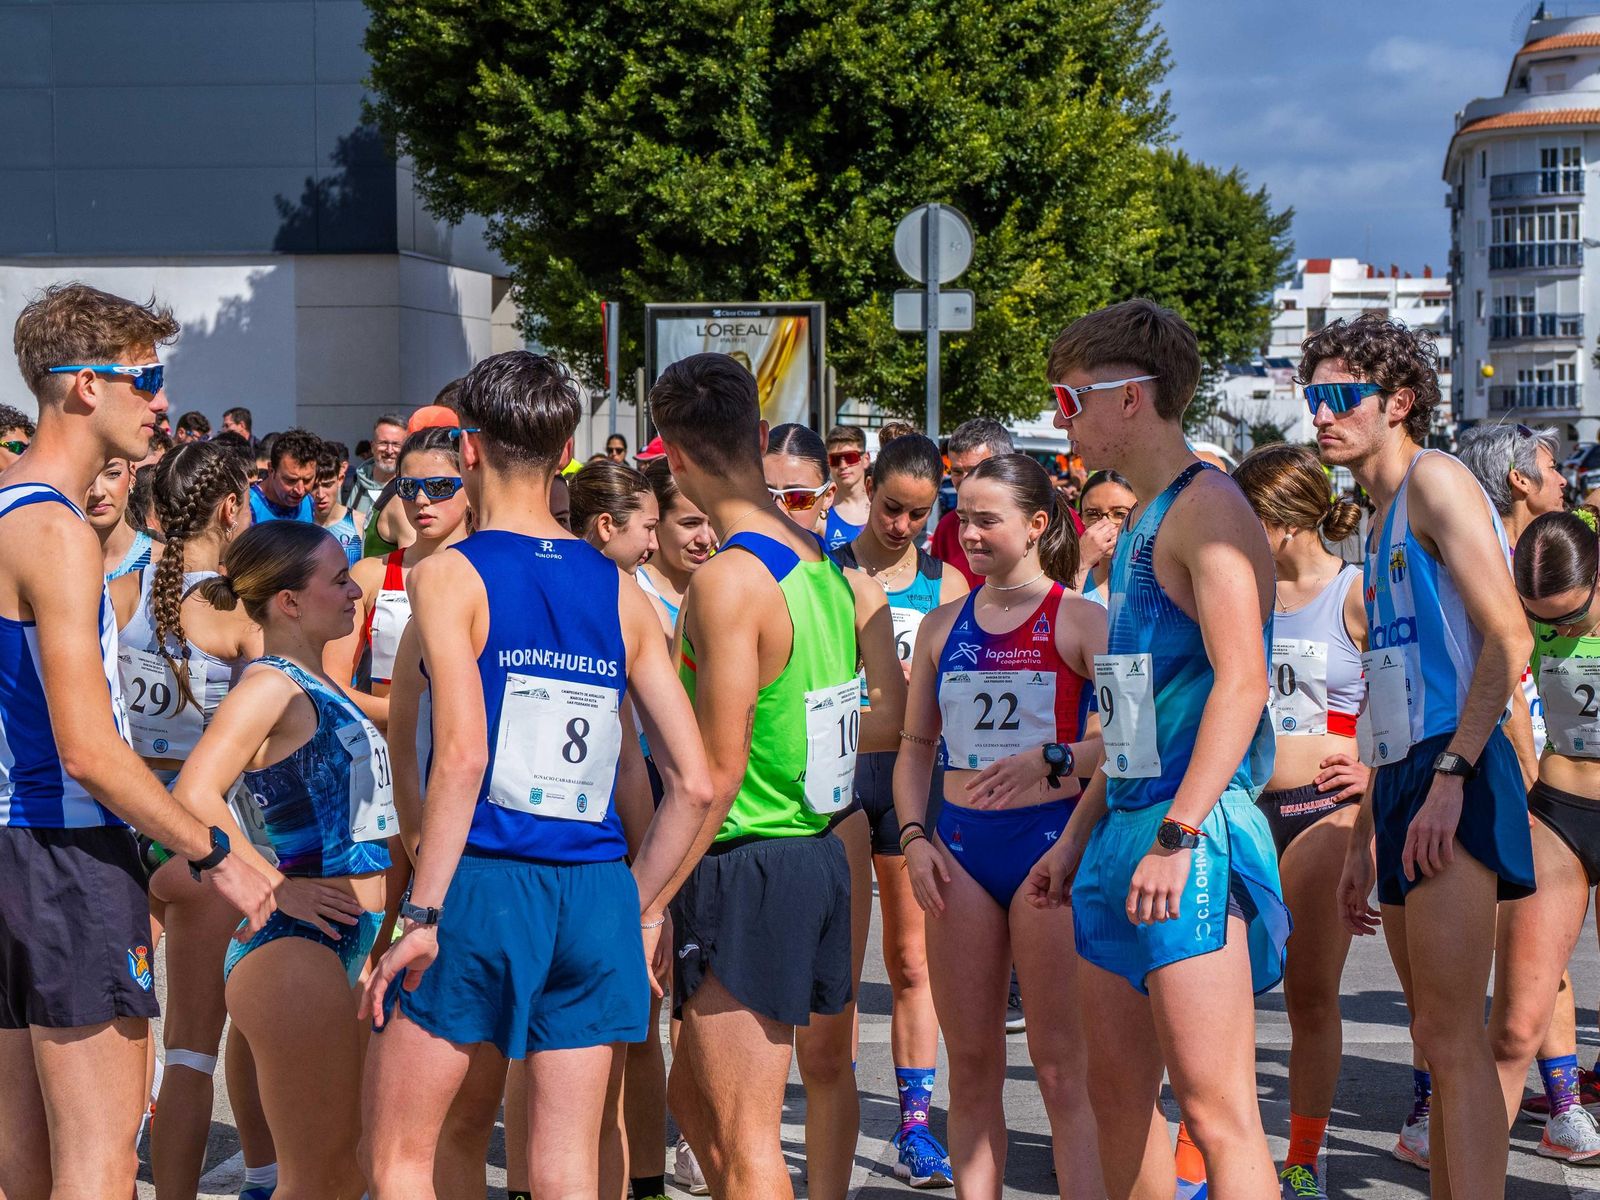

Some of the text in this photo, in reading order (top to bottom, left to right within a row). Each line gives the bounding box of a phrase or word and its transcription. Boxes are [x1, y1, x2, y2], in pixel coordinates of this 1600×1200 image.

[985, 648, 1041, 663] lapalma
[1000, 658, 1041, 666] cooperativa
[129, 676, 171, 717] 29
[1272, 663, 1296, 696] 0
[973, 692, 1020, 730] 22
[1100, 685, 1114, 728] 9
[1574, 684, 1599, 718] 2
[562, 717, 590, 764] 8
[837, 709, 859, 758] 10
[375, 745, 391, 789] 31
